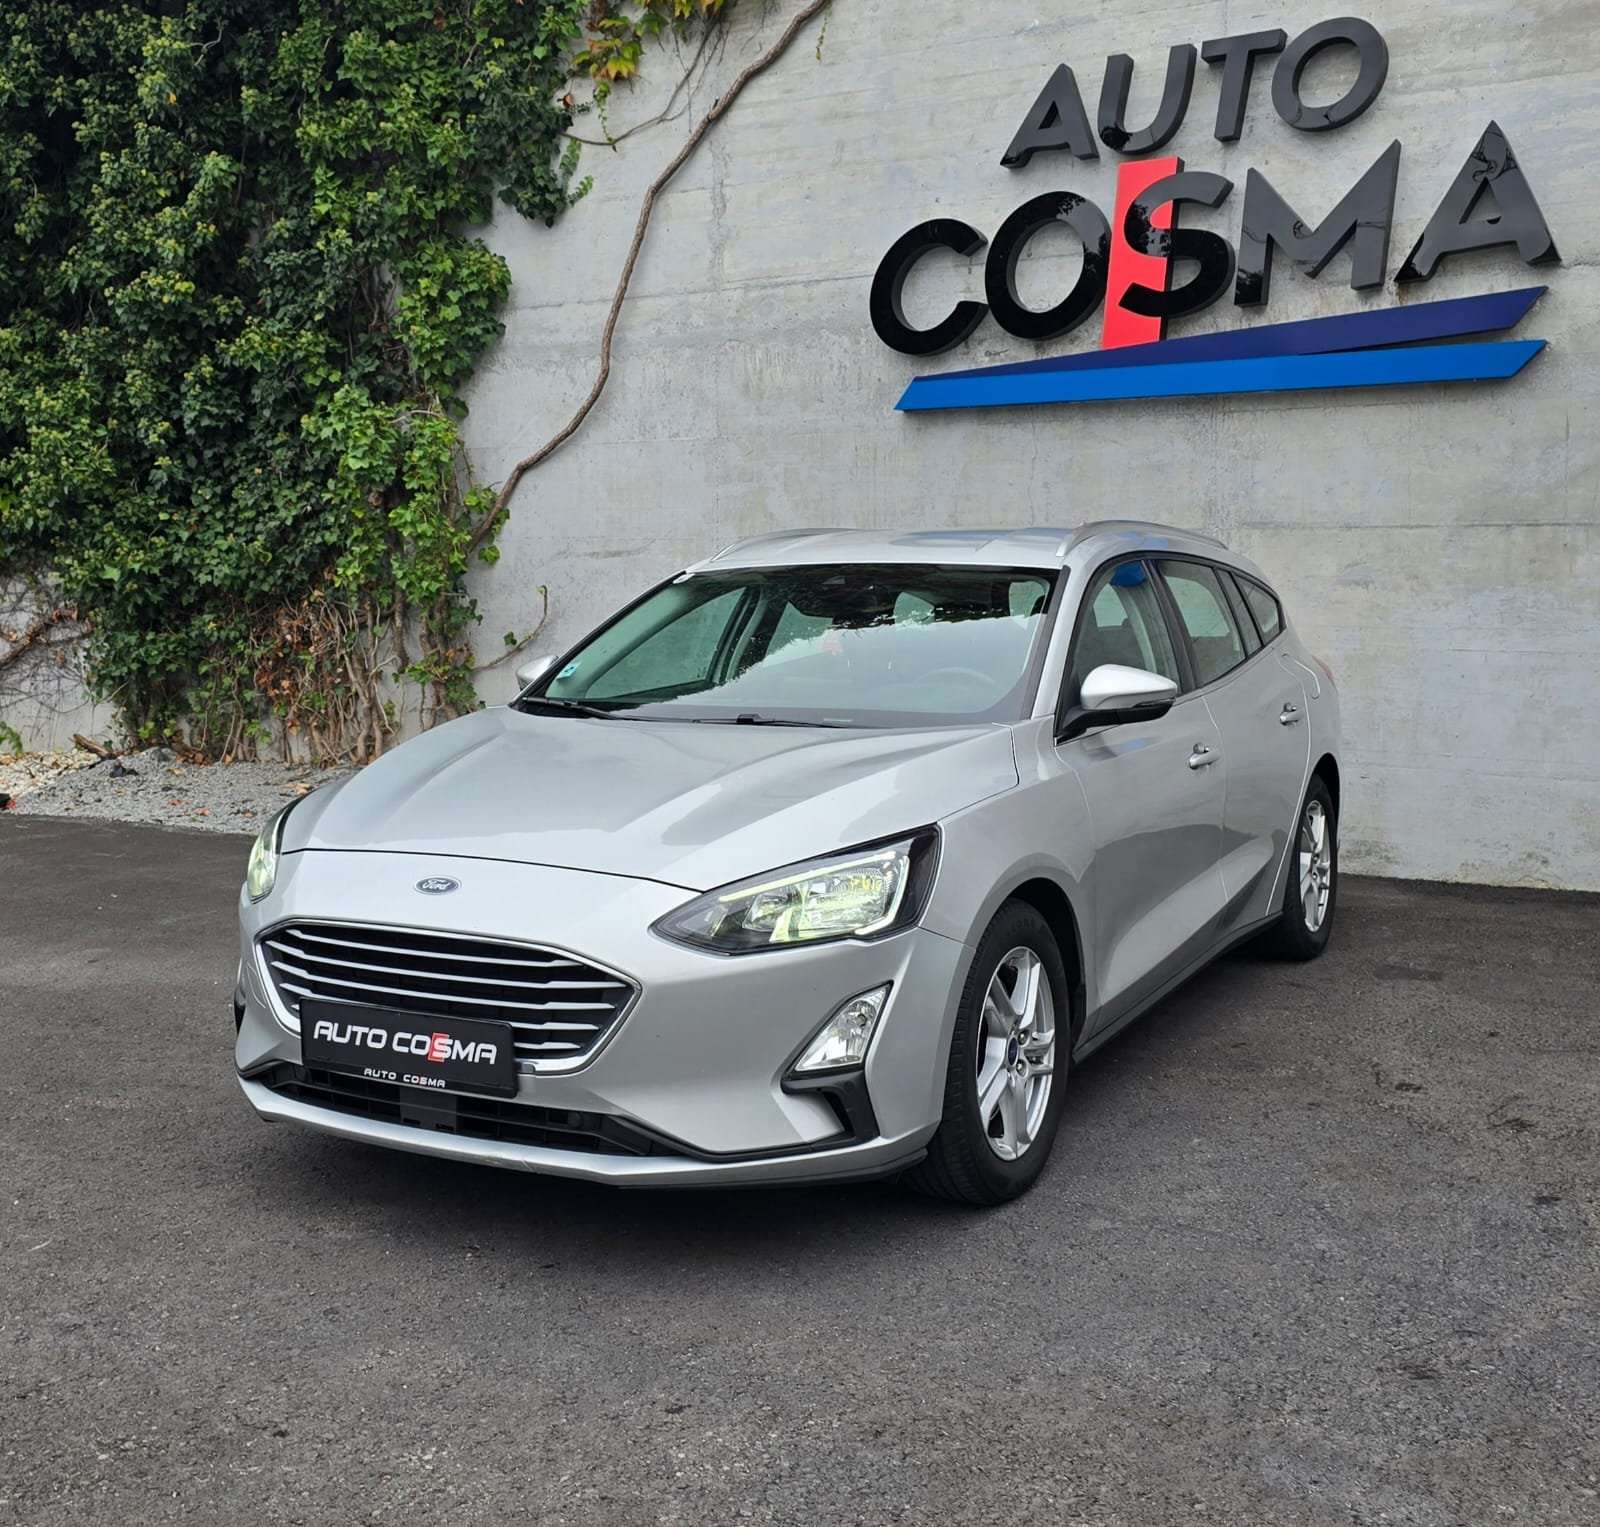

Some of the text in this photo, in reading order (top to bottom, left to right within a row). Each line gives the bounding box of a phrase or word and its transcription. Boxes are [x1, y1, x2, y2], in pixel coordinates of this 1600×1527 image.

[1000, 16, 1389, 170] AUTO
[870, 120, 1561, 357] COSMA
[313, 1020, 497, 1064] AUTO COSMA
[363, 1067, 446, 1088] AUTO COSMA
